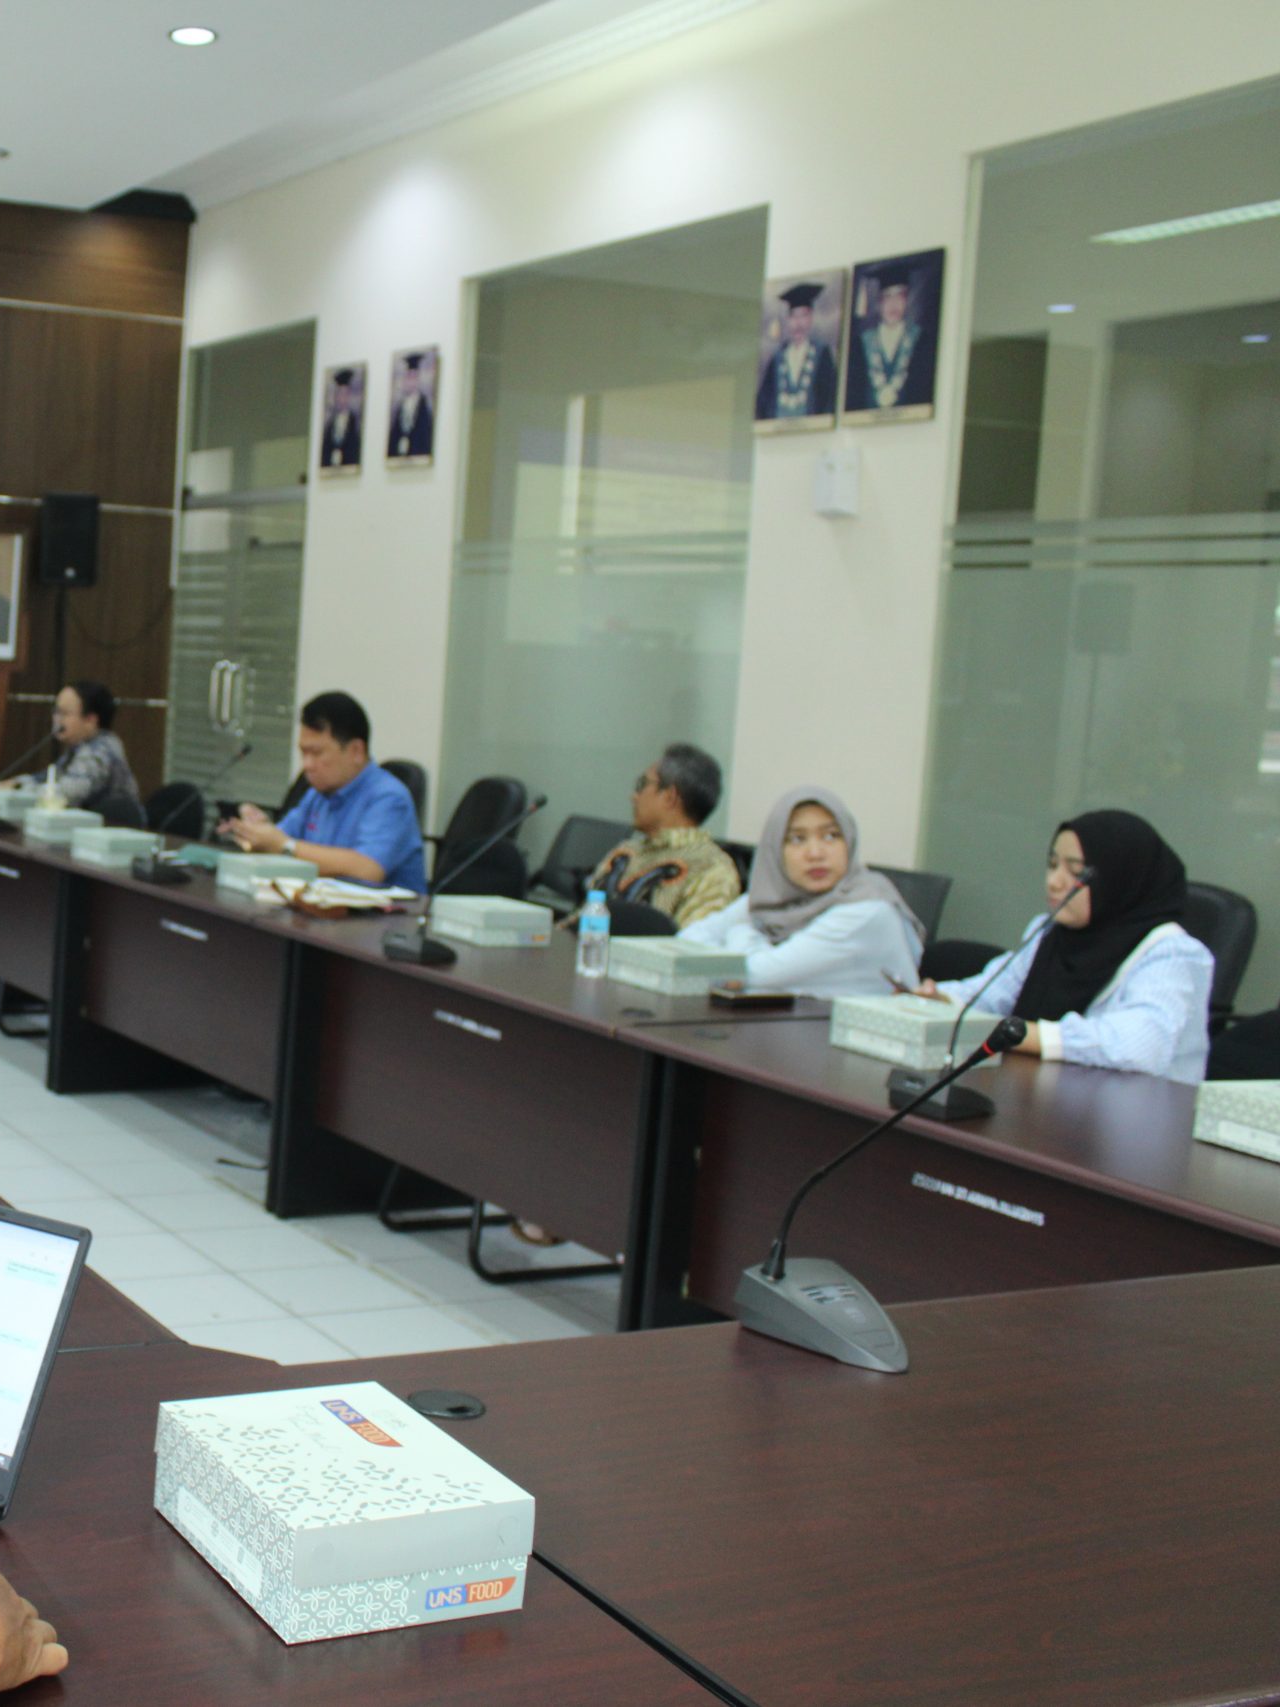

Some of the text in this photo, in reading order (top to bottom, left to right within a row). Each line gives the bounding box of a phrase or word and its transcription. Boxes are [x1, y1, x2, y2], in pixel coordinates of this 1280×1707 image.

[324, 1401, 366, 1422] UNS
[428, 1581, 504, 1609] UNS FOOD
